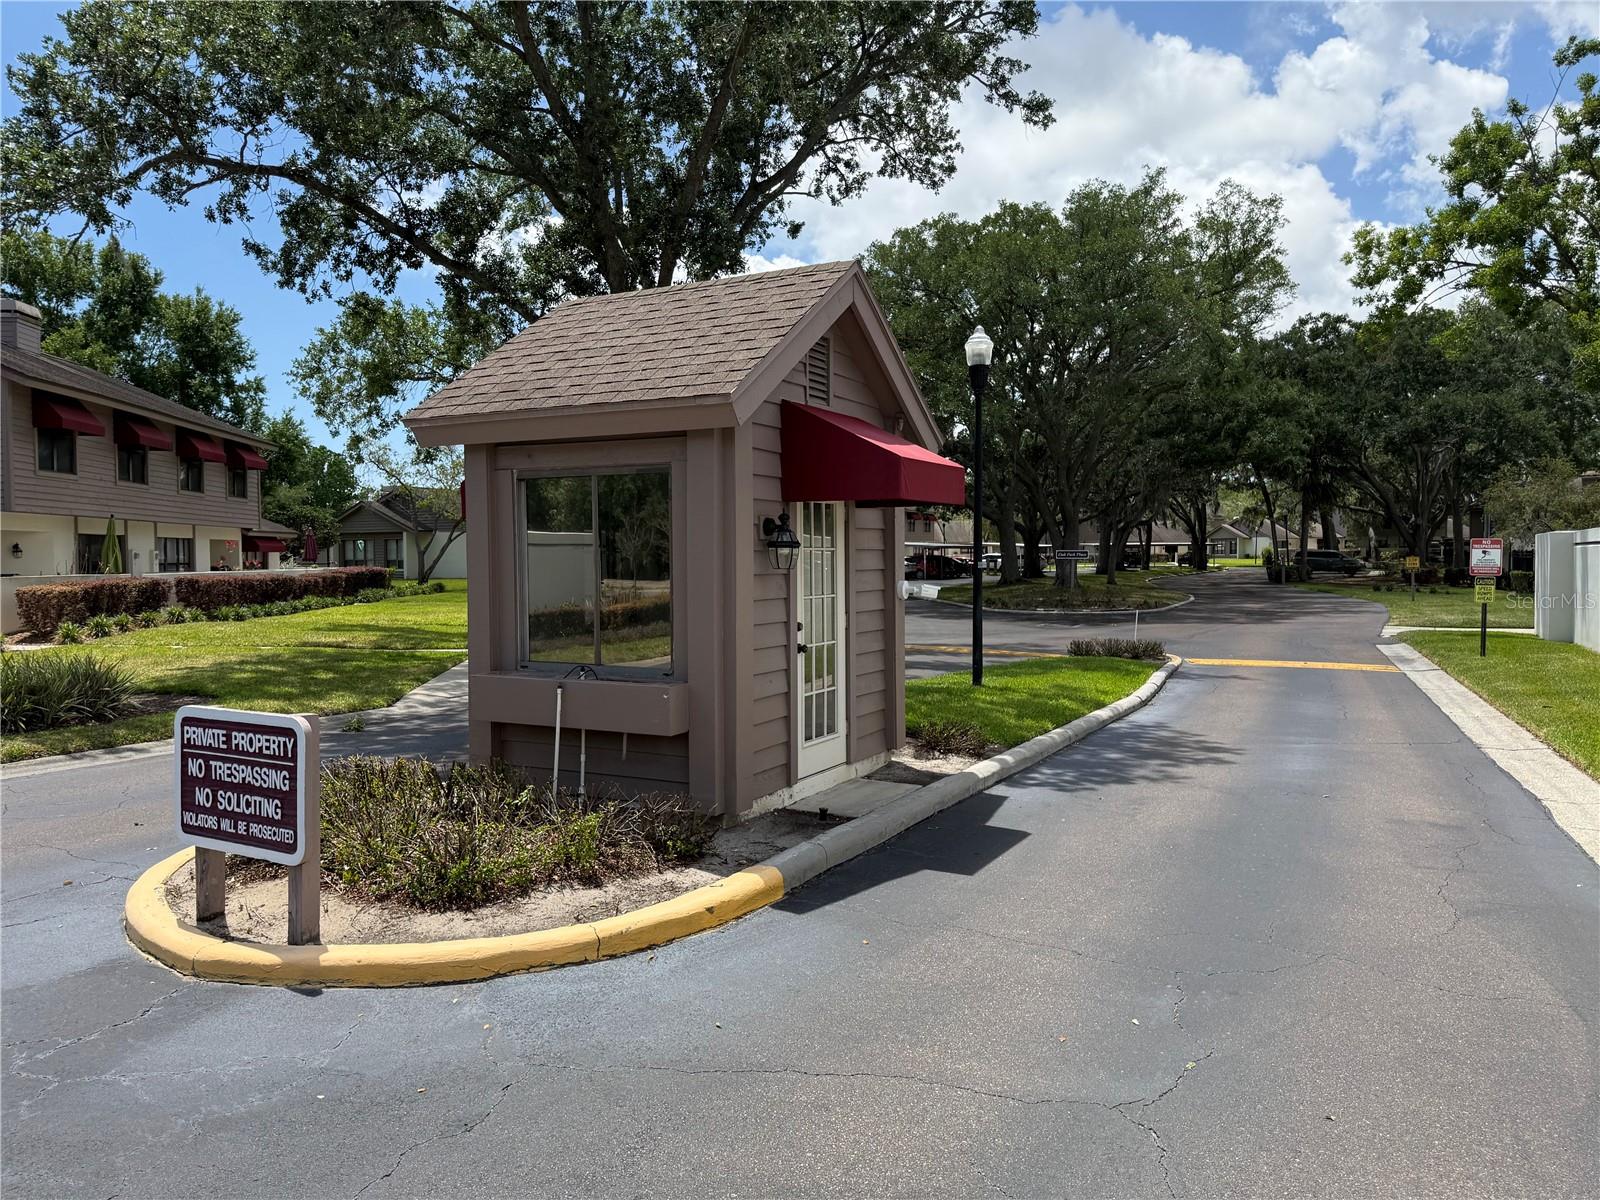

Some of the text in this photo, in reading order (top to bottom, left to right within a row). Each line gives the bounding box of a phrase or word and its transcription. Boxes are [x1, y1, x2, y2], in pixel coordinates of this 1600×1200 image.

[184, 726, 294, 758] PRIVATE PROPERTY
[188, 758, 290, 791] NO TRESPASSING
[195, 787, 282, 820] NO SOLICITING
[183, 811, 294, 844] VIOLATORS WILL BE PROSECUTED
